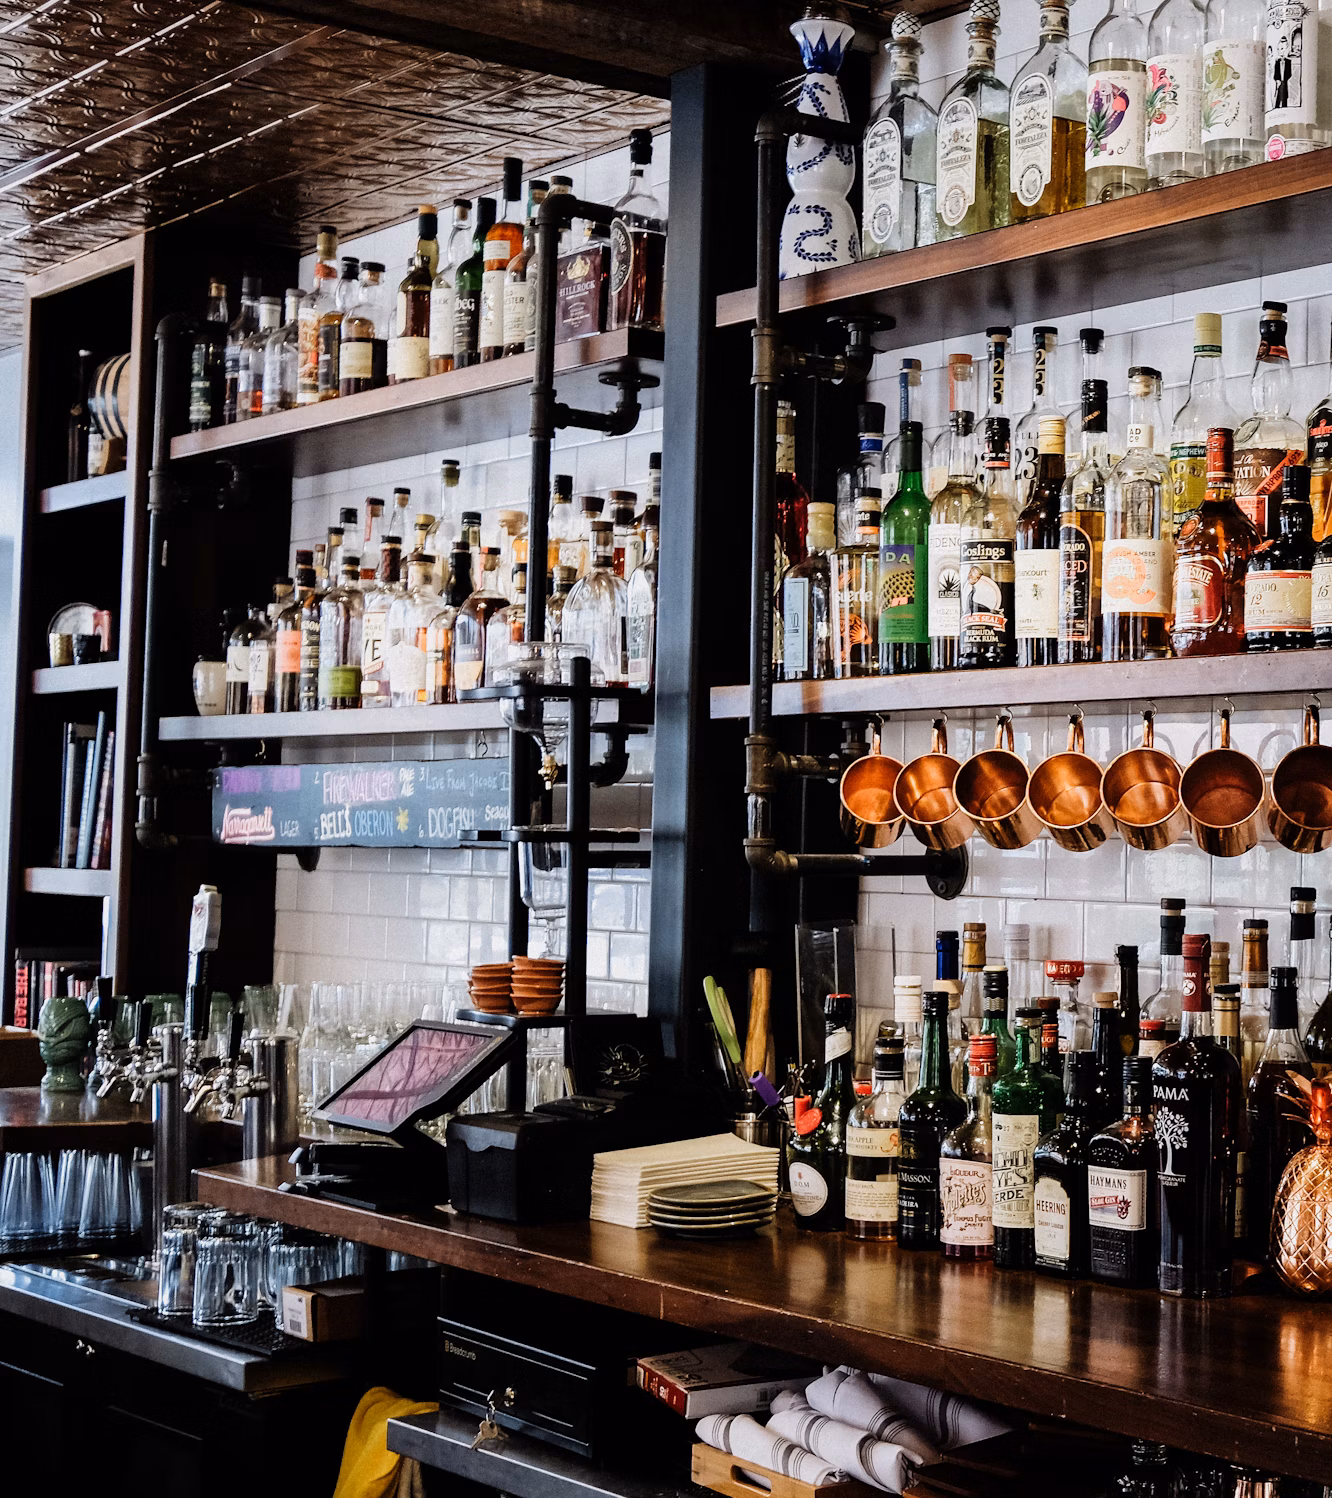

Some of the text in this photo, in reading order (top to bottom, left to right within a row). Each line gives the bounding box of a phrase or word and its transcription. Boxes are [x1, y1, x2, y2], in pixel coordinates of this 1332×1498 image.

[559, 280, 596, 298] HILLROCK
[1129, 428, 1141, 436] AD
[960, 544, 1005, 560] Goslings
[1188, 567, 1214, 585] ESTATE
[835, 589, 873, 603] suerte
[1316, 584, 1329, 598] 15
[1249, 593, 1263, 606] 12
[982, 615, 1000, 624] SEAL
[965, 628, 995, 637] BERMUDA
[981, 635, 999, 643] RUM
[280, 820, 300, 837] LAGER
[354, 809, 394, 838] OBERON
[428, 806, 475, 840] DOGFISH
[1153, 1085, 1190, 1102] PAMA
[855, 1136, 874, 1144] APPLE
[855, 1142, 878, 1151] WHISKEY
[1157, 1174, 1186, 1184] POMEGRANATE
[898, 1199, 919, 1209] ADEIRA
[1090, 1195, 1117, 1207] SLOE GIN
[1036, 1200, 1066, 1216] HEERING
[953, 1213, 974, 1223] TEMPUS
[449, 1341, 477, 1361] Breadcrumb
